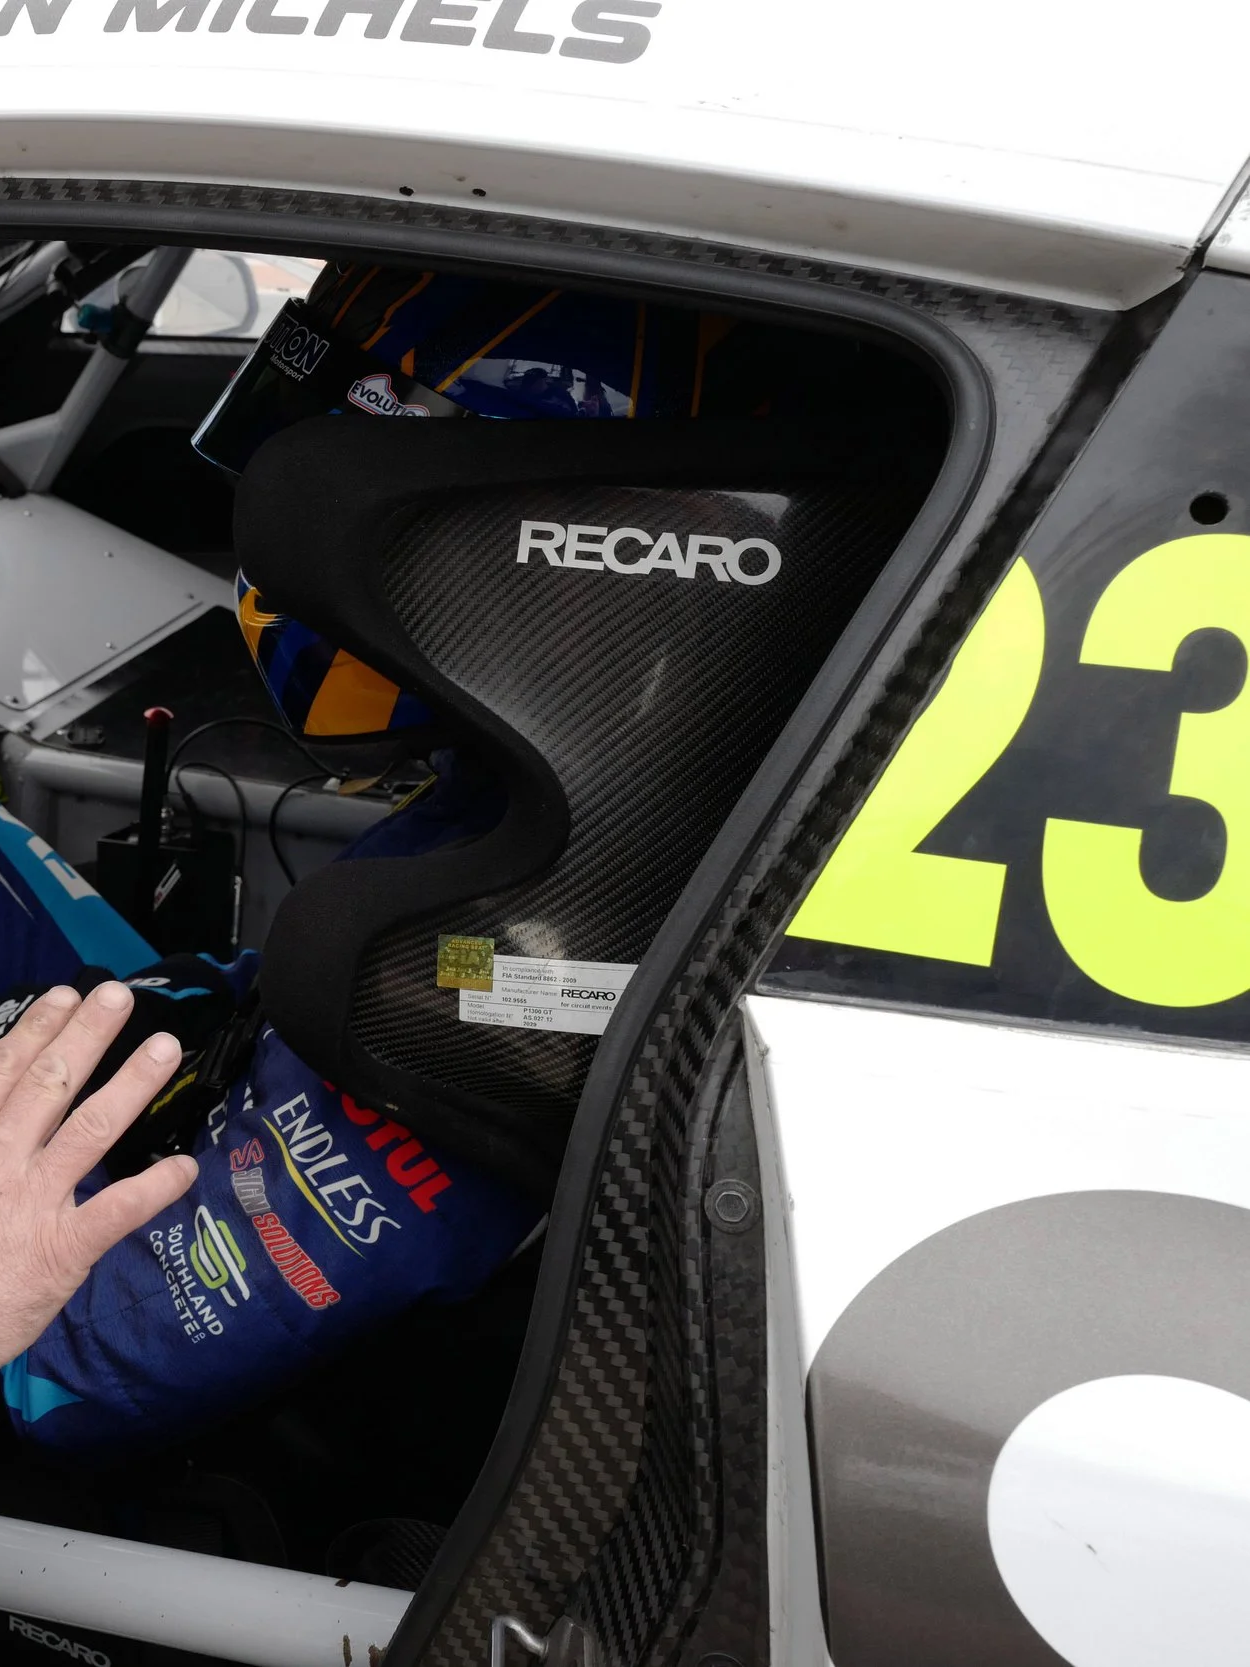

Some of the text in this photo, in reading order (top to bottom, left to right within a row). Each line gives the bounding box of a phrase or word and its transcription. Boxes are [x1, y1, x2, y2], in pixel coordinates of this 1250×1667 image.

[104, 0, 664, 64] MICHELS
[270, 354, 305, 382] Motorsport
[516, 520, 781, 586] RECARO
[784, 533, 1250, 1008] 23
[514, 973, 542, 982] Standard
[561, 988, 617, 1001] RECARO
[273, 1092, 402, 1243] ENDLESS
[149, 1230, 201, 1337] CONCRETE
[167, 1223, 224, 1335] SOUTHLAND
[252, 1212, 341, 1311] SOLUTIONS
[191, 1331, 206, 1344] LTD
[9, 1614, 114, 1667] RECARO
